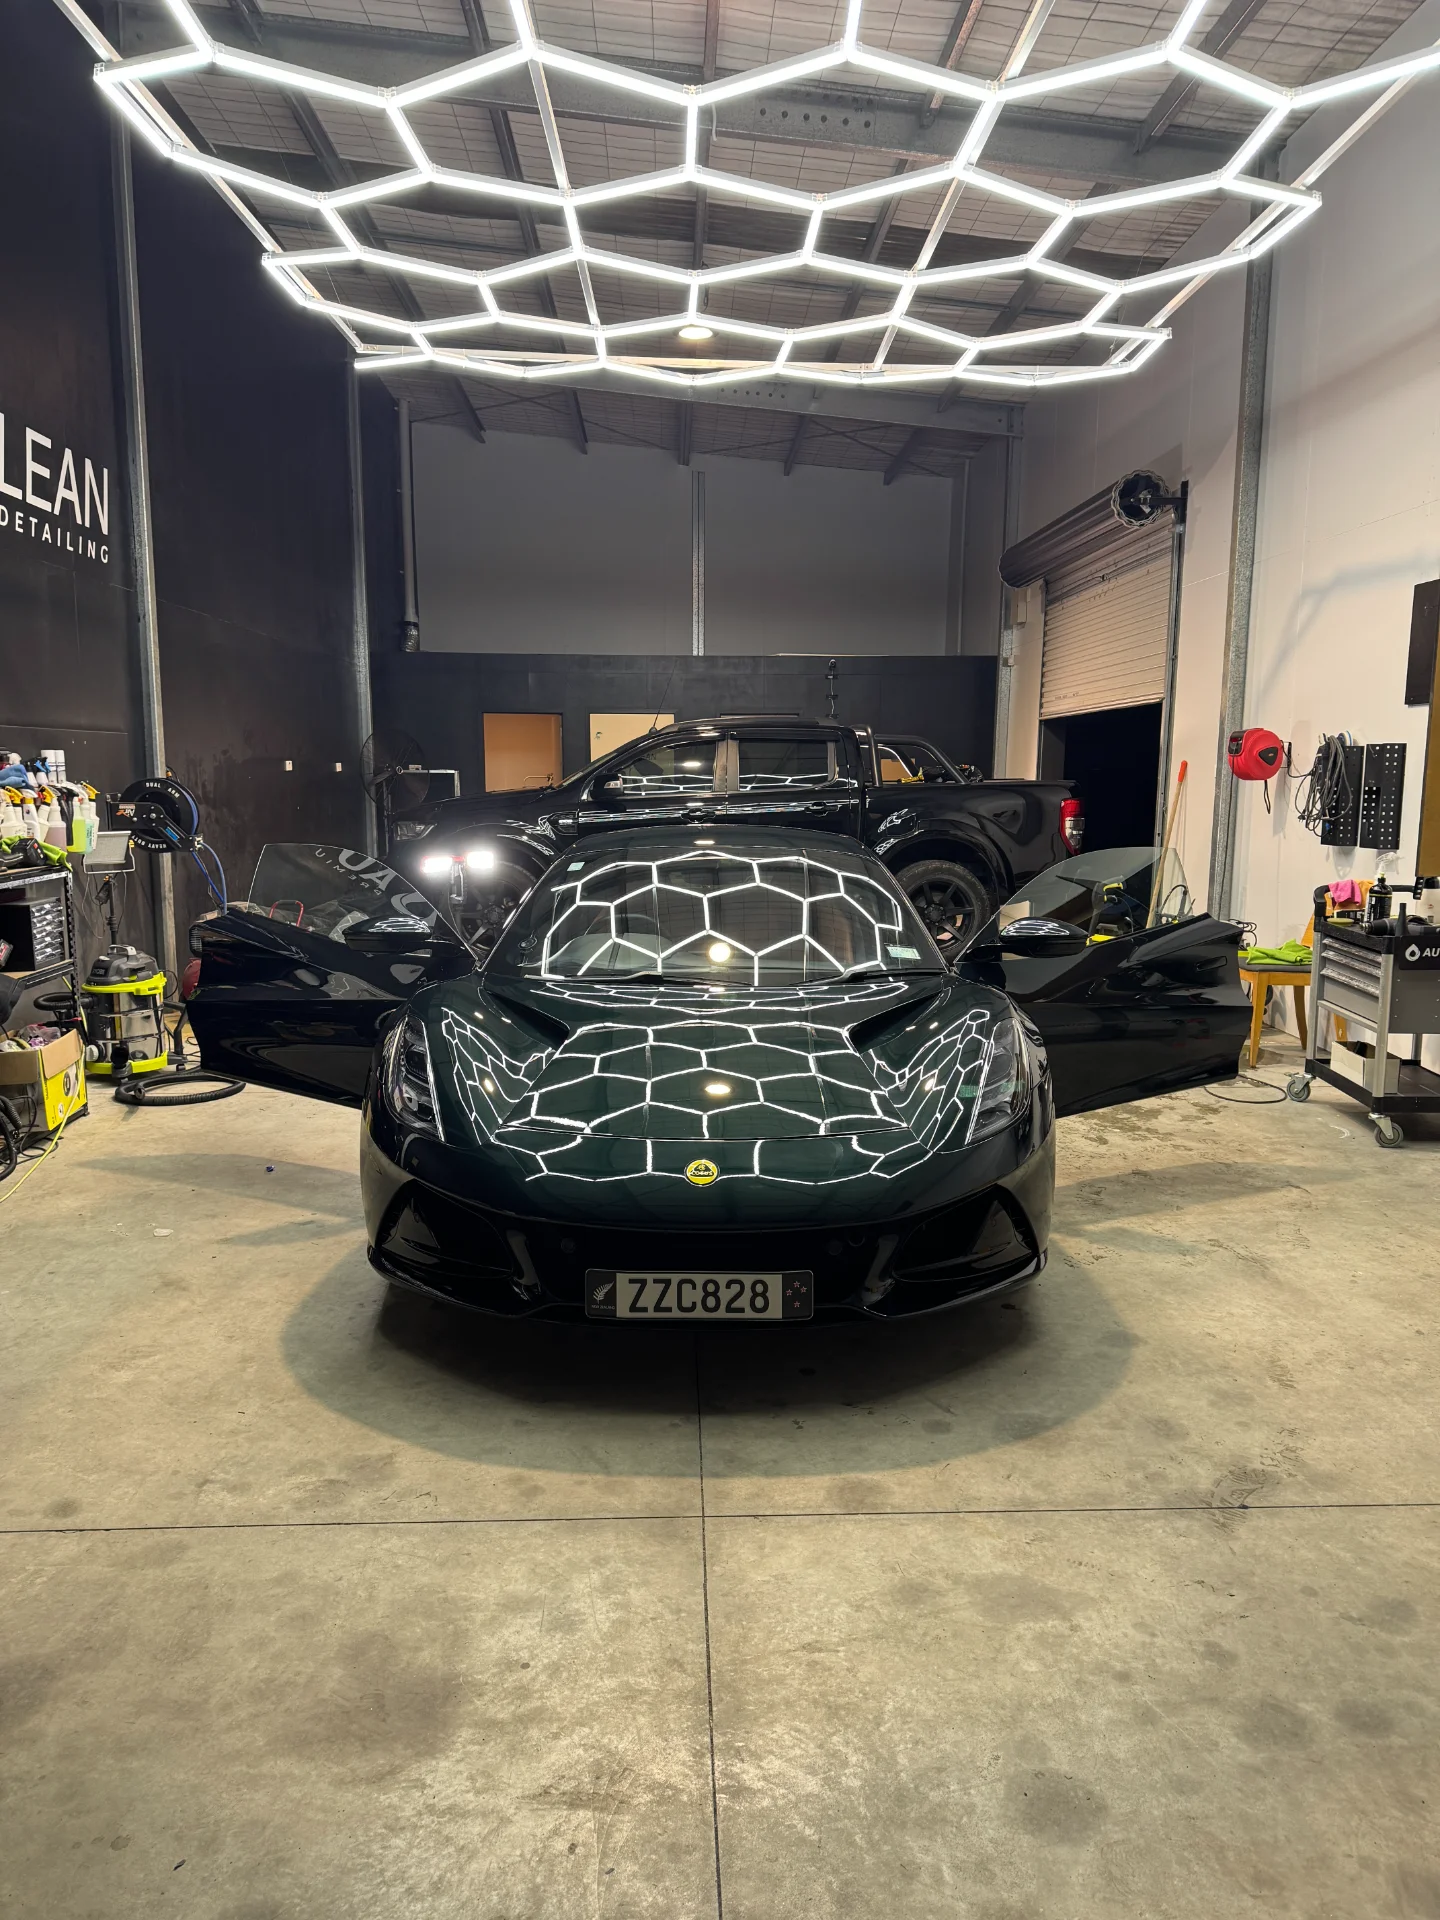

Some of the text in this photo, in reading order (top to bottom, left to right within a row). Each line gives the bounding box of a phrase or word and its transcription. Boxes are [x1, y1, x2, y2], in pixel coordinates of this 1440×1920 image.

[0, 412, 108, 536] LEAN
[0, 506, 108, 563] DETAILING
[167, 787, 180, 798] ARM
[628, 1278, 770, 1314] ZZC828
